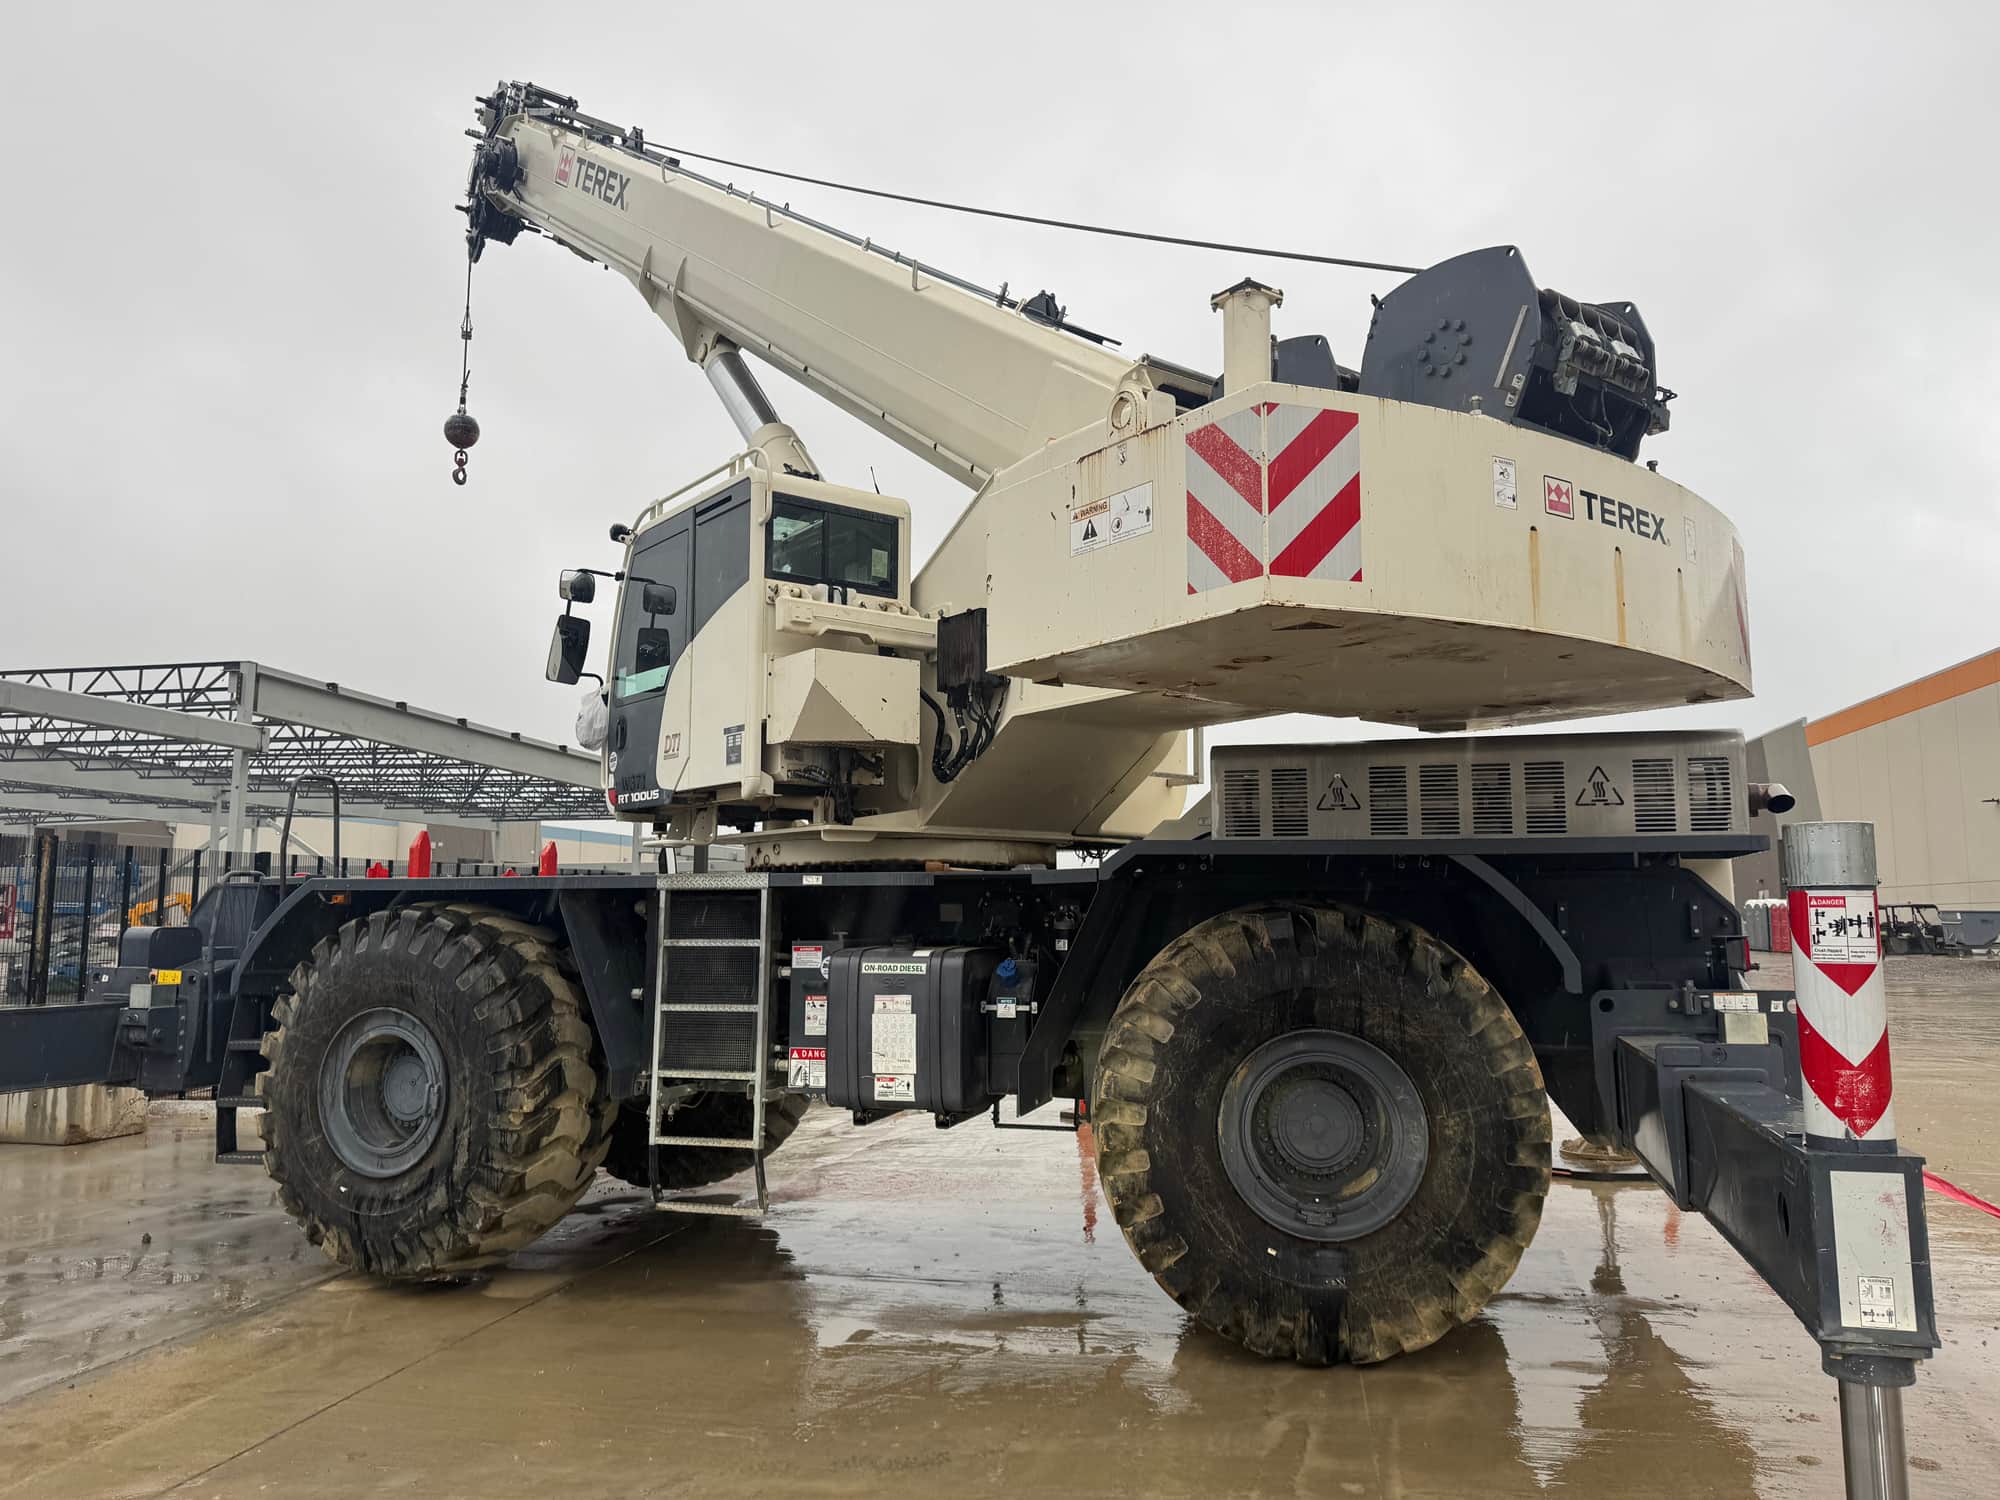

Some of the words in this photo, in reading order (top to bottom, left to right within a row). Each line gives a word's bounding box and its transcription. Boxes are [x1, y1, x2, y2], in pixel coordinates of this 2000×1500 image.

[574, 156, 631, 211] TEREX
[1080, 501, 1108, 518] WARNING
[1579, 489, 1667, 546] TEREX
[618, 793, 629, 805] RT
[1817, 898, 1845, 906] DANGER
[864, 964, 898, 972] ON-ROAD
[899, 965, 924, 973] DIESEL
[801, 1050, 826, 1058] DANG
